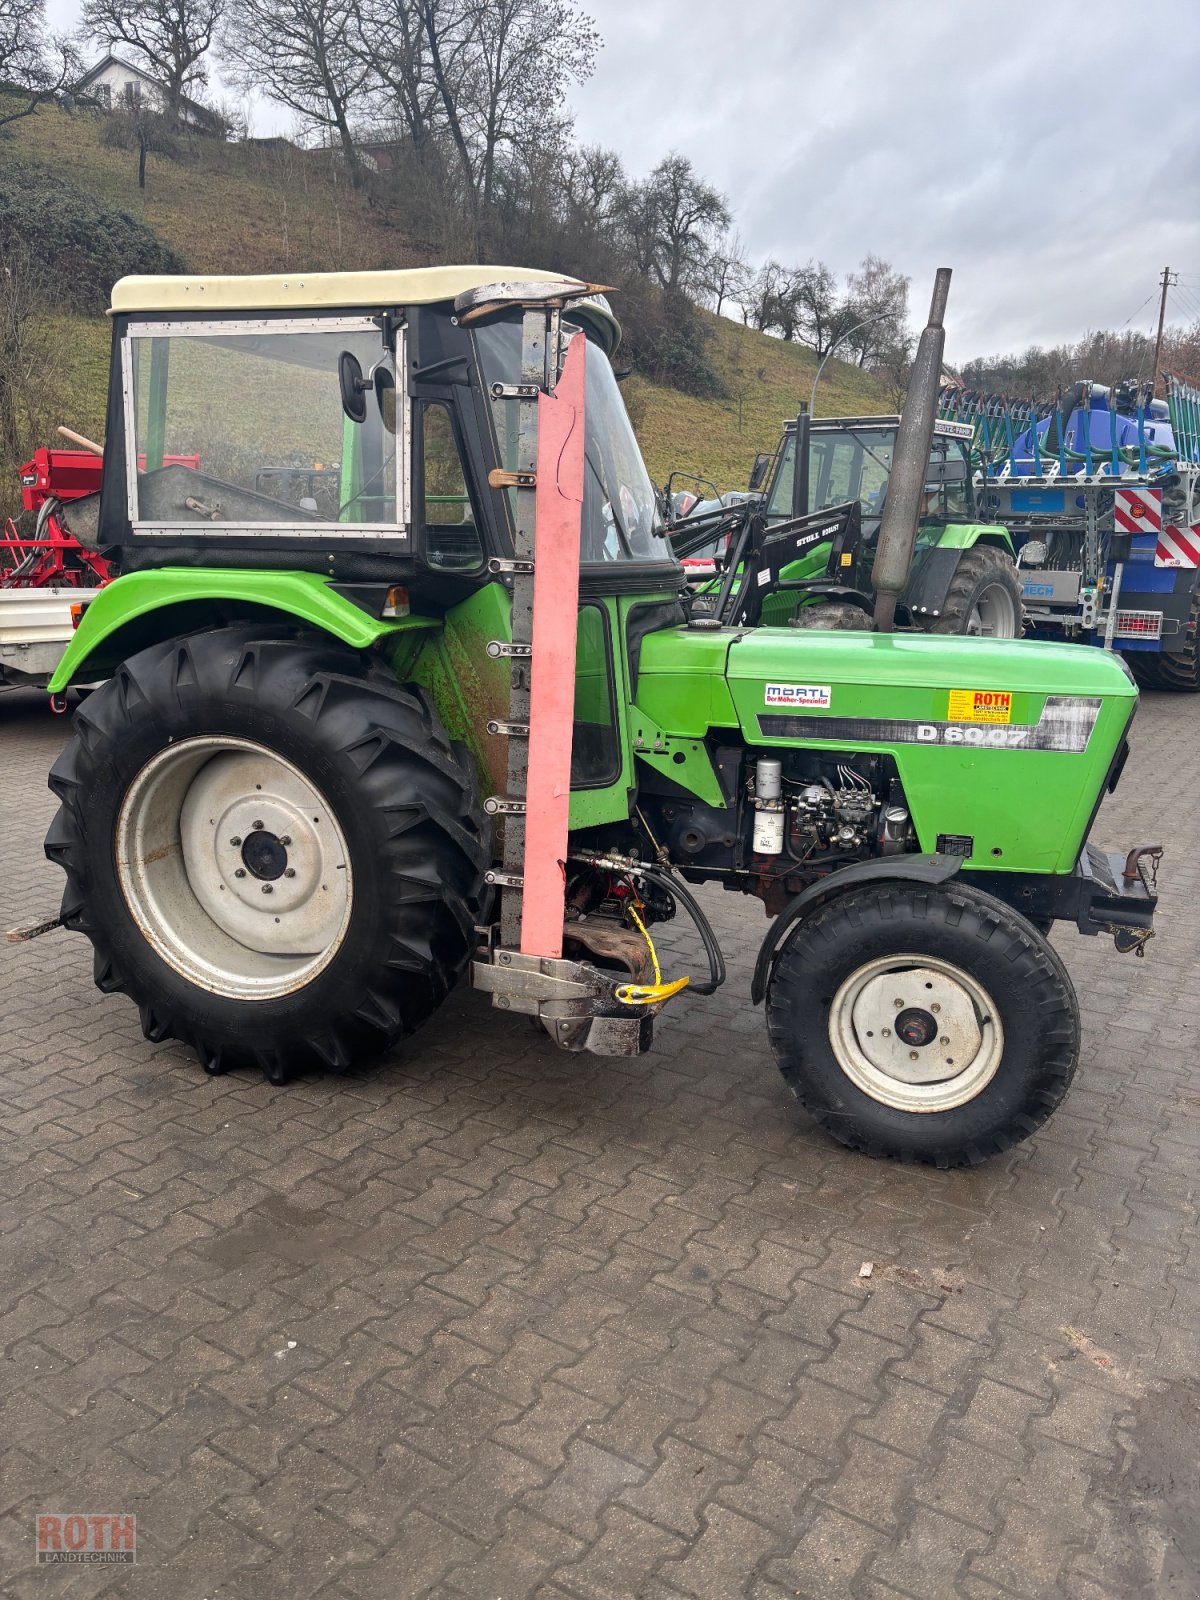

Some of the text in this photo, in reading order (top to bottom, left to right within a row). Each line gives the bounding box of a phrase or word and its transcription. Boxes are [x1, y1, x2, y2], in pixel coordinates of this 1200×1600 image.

[796, 531, 820, 547] STOLL
[777, 696, 828, 705] Mäher-Spezialist
[973, 692, 1011, 706] ROTH
[916, 725, 1028, 745] D 6007
